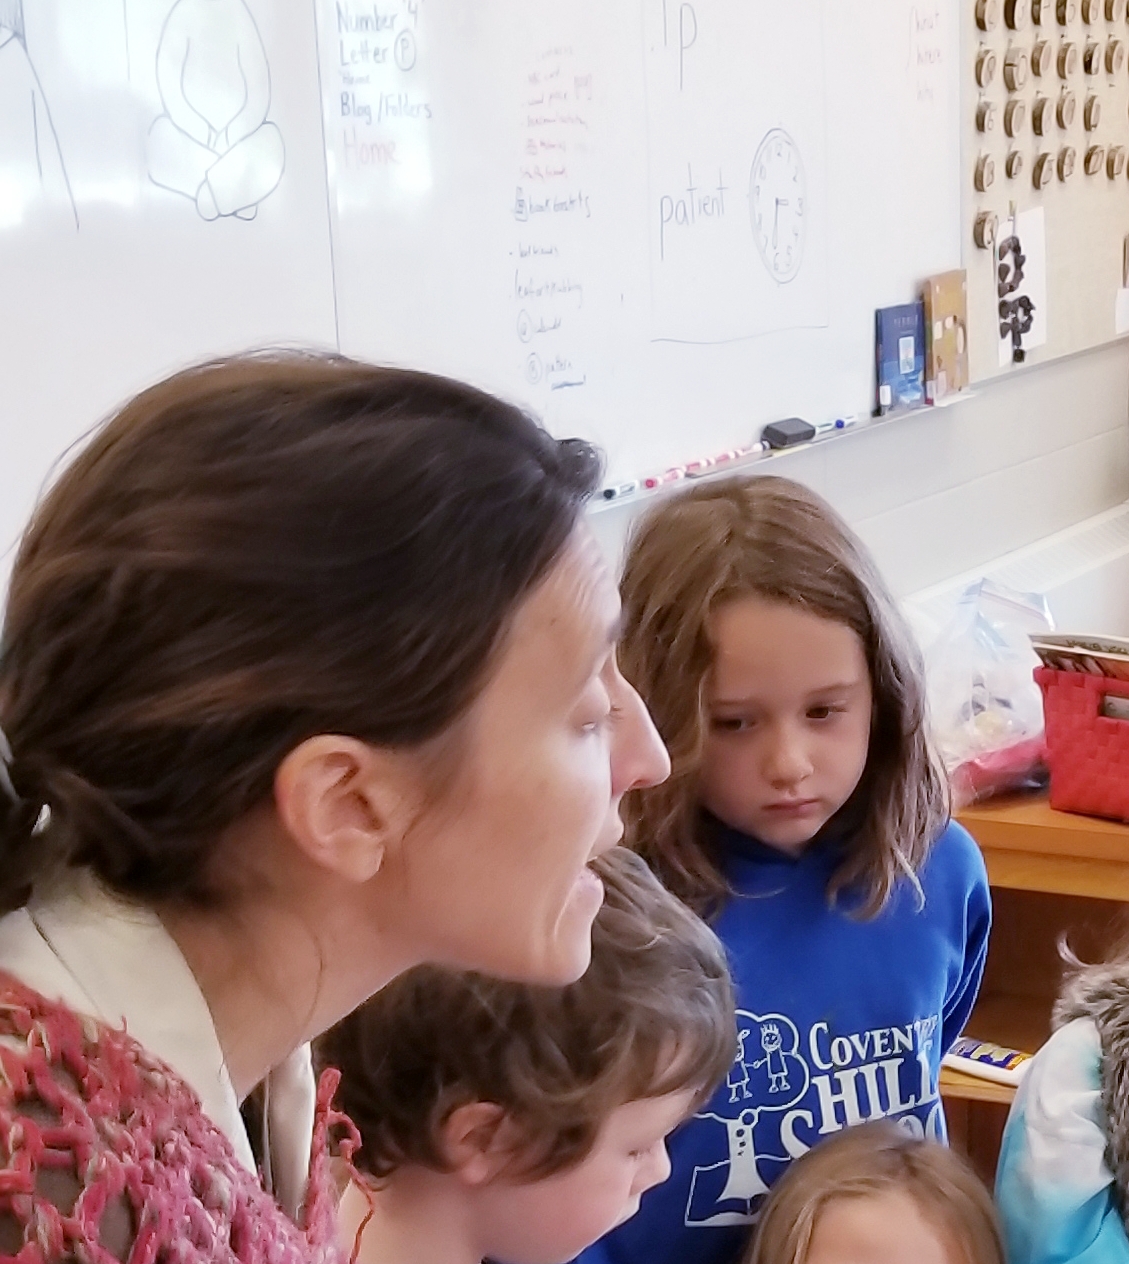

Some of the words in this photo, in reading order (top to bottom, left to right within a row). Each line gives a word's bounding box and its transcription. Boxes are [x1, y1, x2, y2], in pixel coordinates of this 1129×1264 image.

[336, 0, 398, 34] Number
[340, 39, 389, 66] Letter
[659, 161, 730, 262] patient
